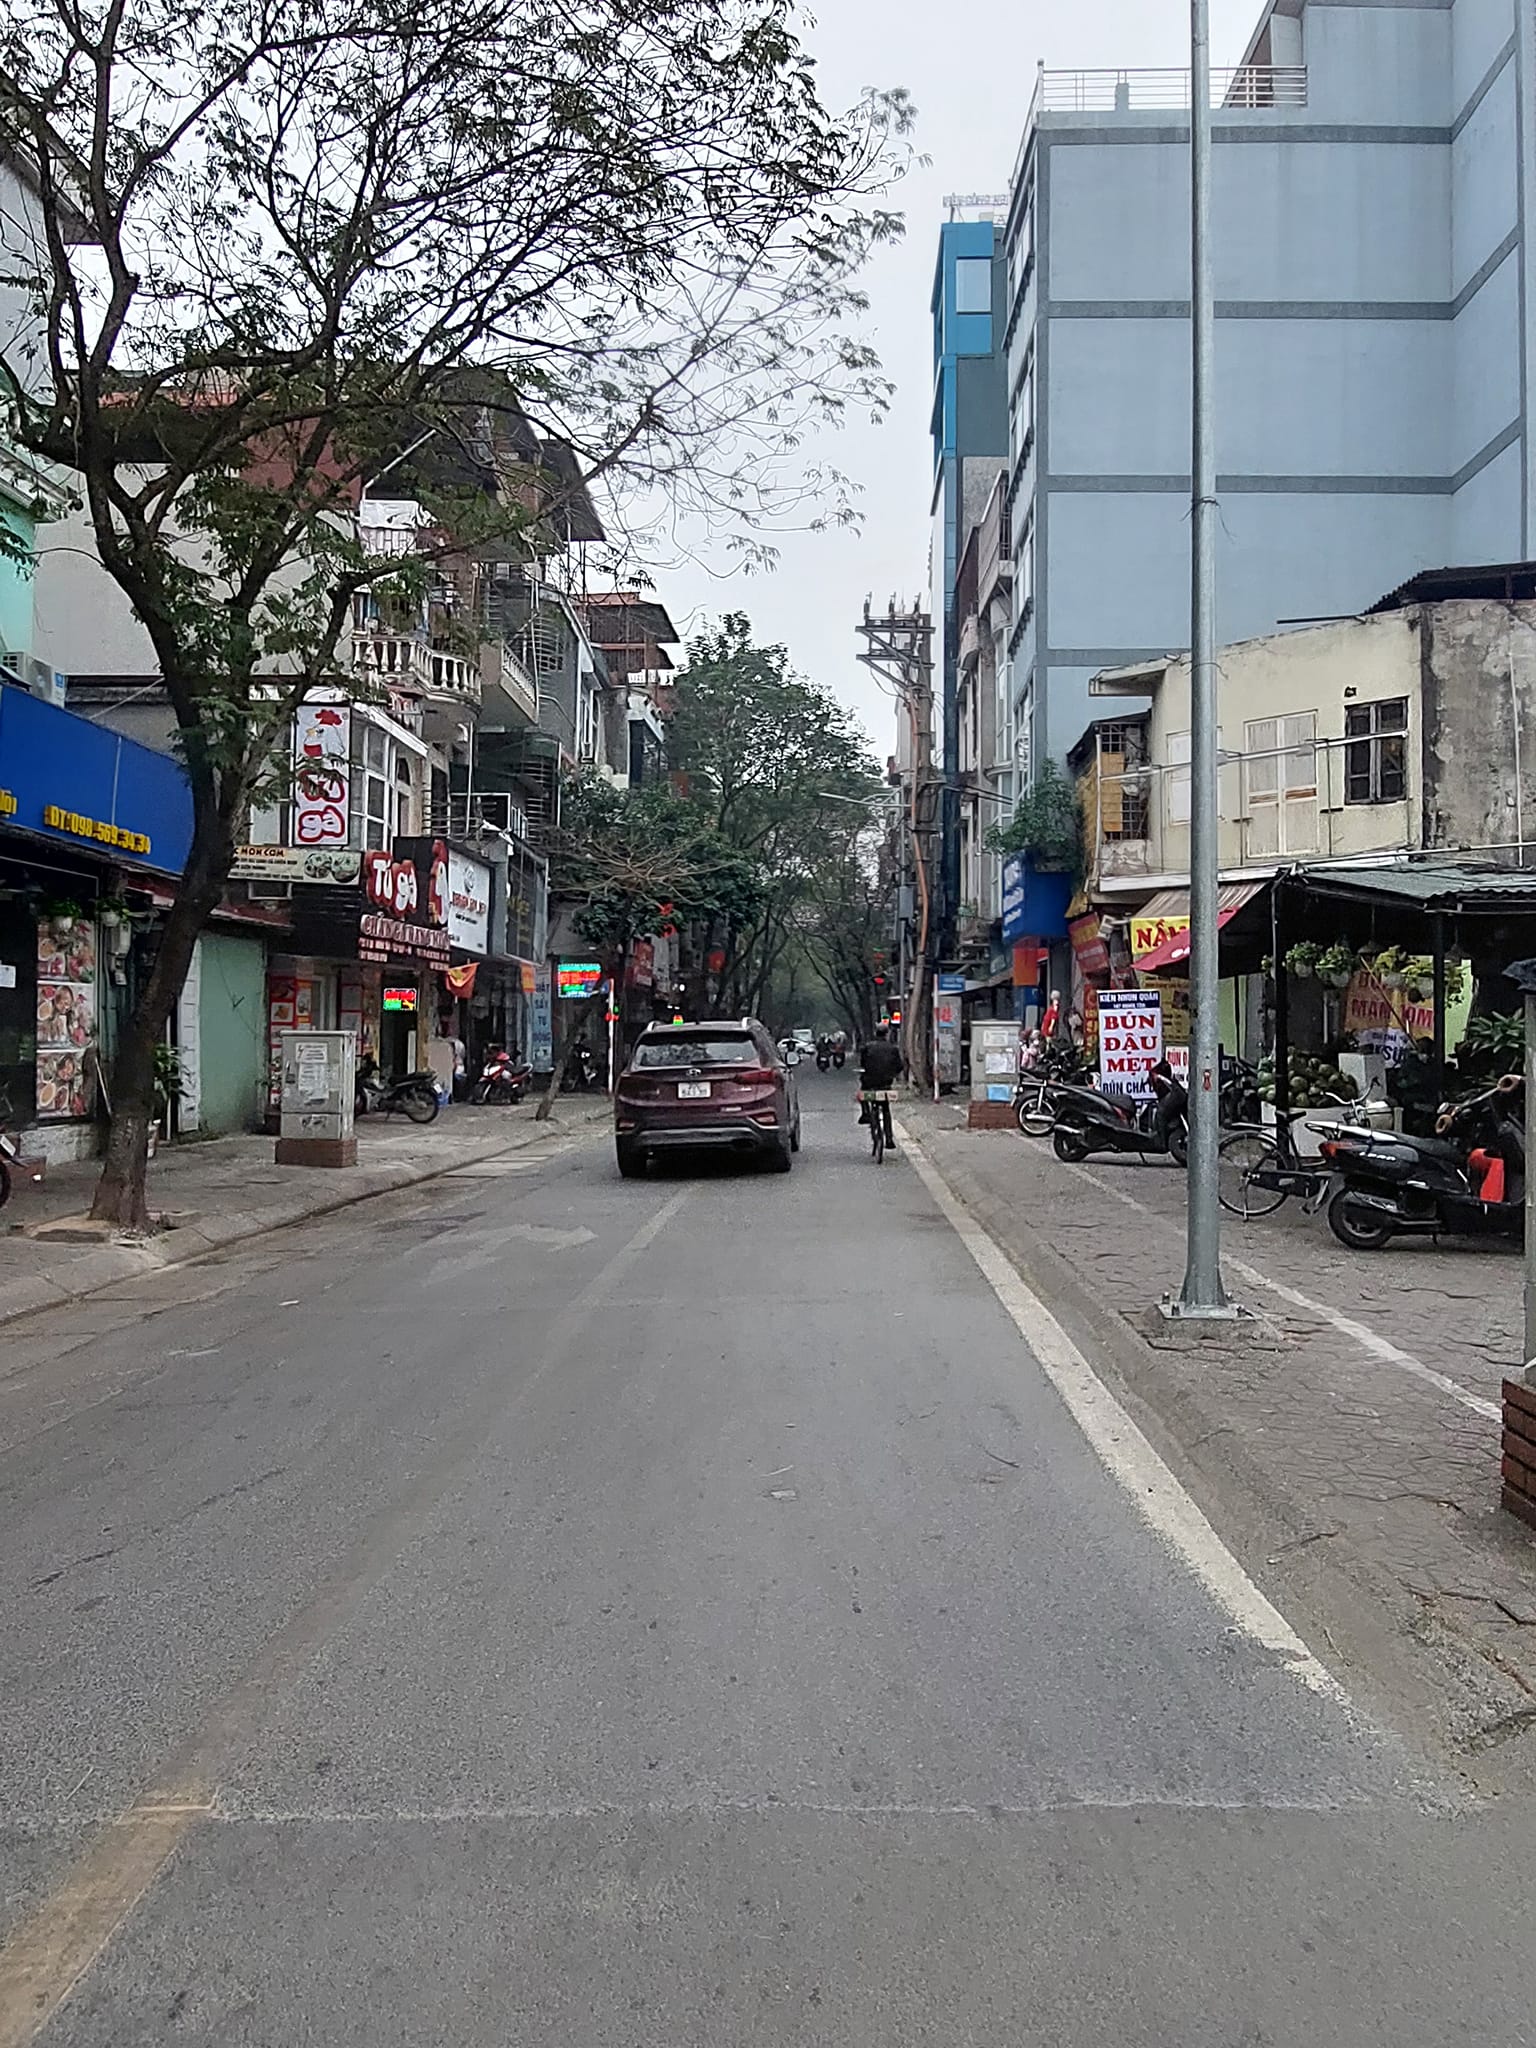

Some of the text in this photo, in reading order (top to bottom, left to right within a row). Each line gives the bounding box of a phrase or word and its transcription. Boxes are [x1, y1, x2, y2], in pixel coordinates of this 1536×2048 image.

[1104, 1011, 1156, 1031] BÚN
[1103, 1032, 1158, 1055] ĐẬU
[1106, 1056, 1157, 1075] MẸT
[1103, 1080, 1124, 1095] BÚN
